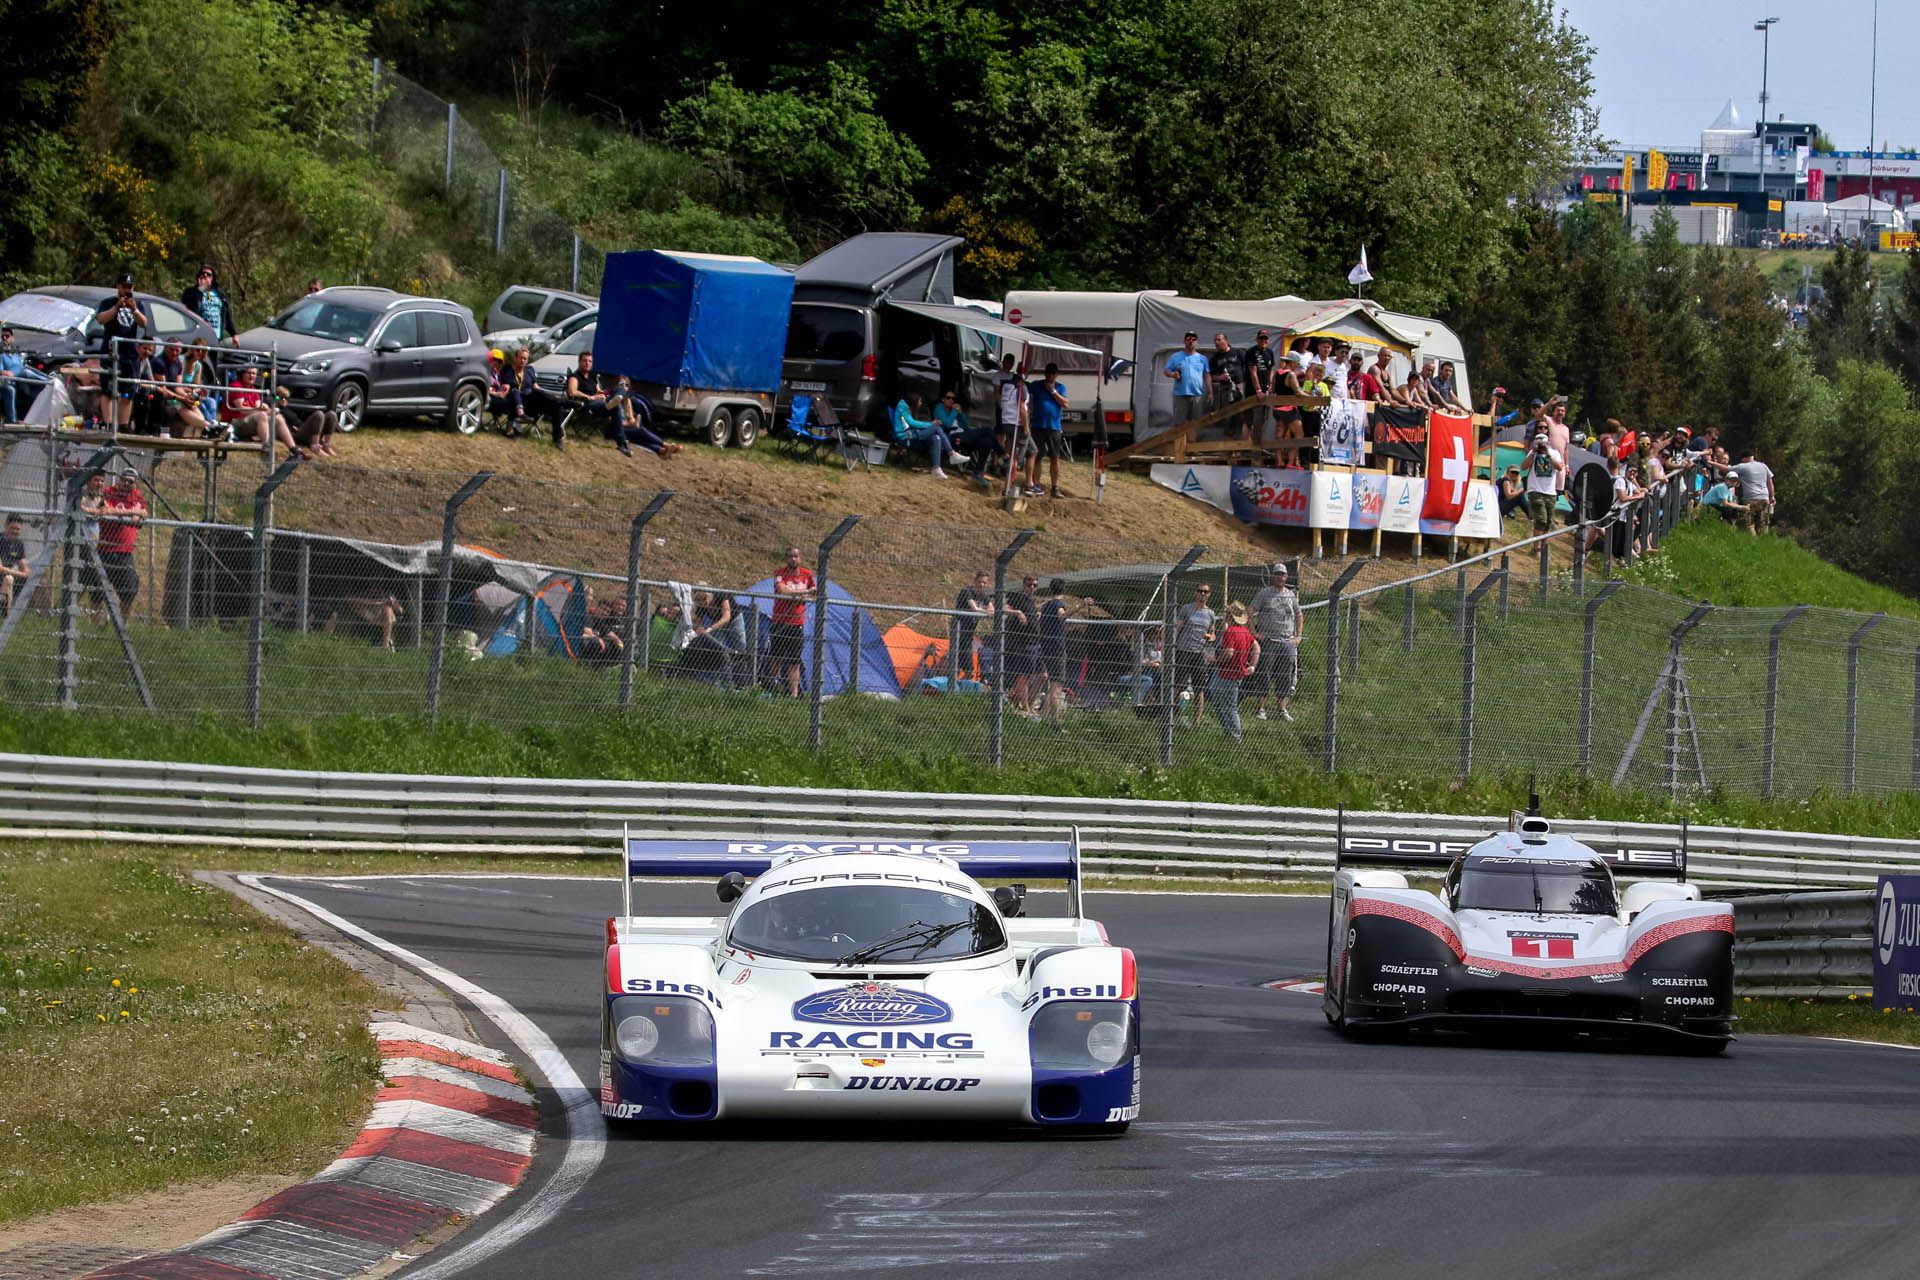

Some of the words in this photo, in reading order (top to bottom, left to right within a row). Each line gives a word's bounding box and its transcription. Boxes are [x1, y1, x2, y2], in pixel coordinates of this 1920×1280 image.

[1257, 486, 1308, 512] 24h
[727, 843, 970, 855] RACING
[1344, 837, 1672, 863] PORHE
[1480, 857, 1595, 868] PORSCHE
[760, 873, 972, 895] PORSCHE
[1527, 939, 1550, 958] 1
[1380, 964, 1439, 976] SCHAEFFLER
[1372, 983, 1426, 994] CHOPARD
[1652, 978, 1708, 987] SCHAEFFLER
[626, 978, 723, 1010] Shell
[1020, 984, 1117, 1013] Shell
[1664, 996, 1715, 1005] CHOPARD
[827, 997, 919, 1014] Racing
[769, 1031, 974, 1049] RACING
[843, 1075, 981, 1092] DUNLOP
